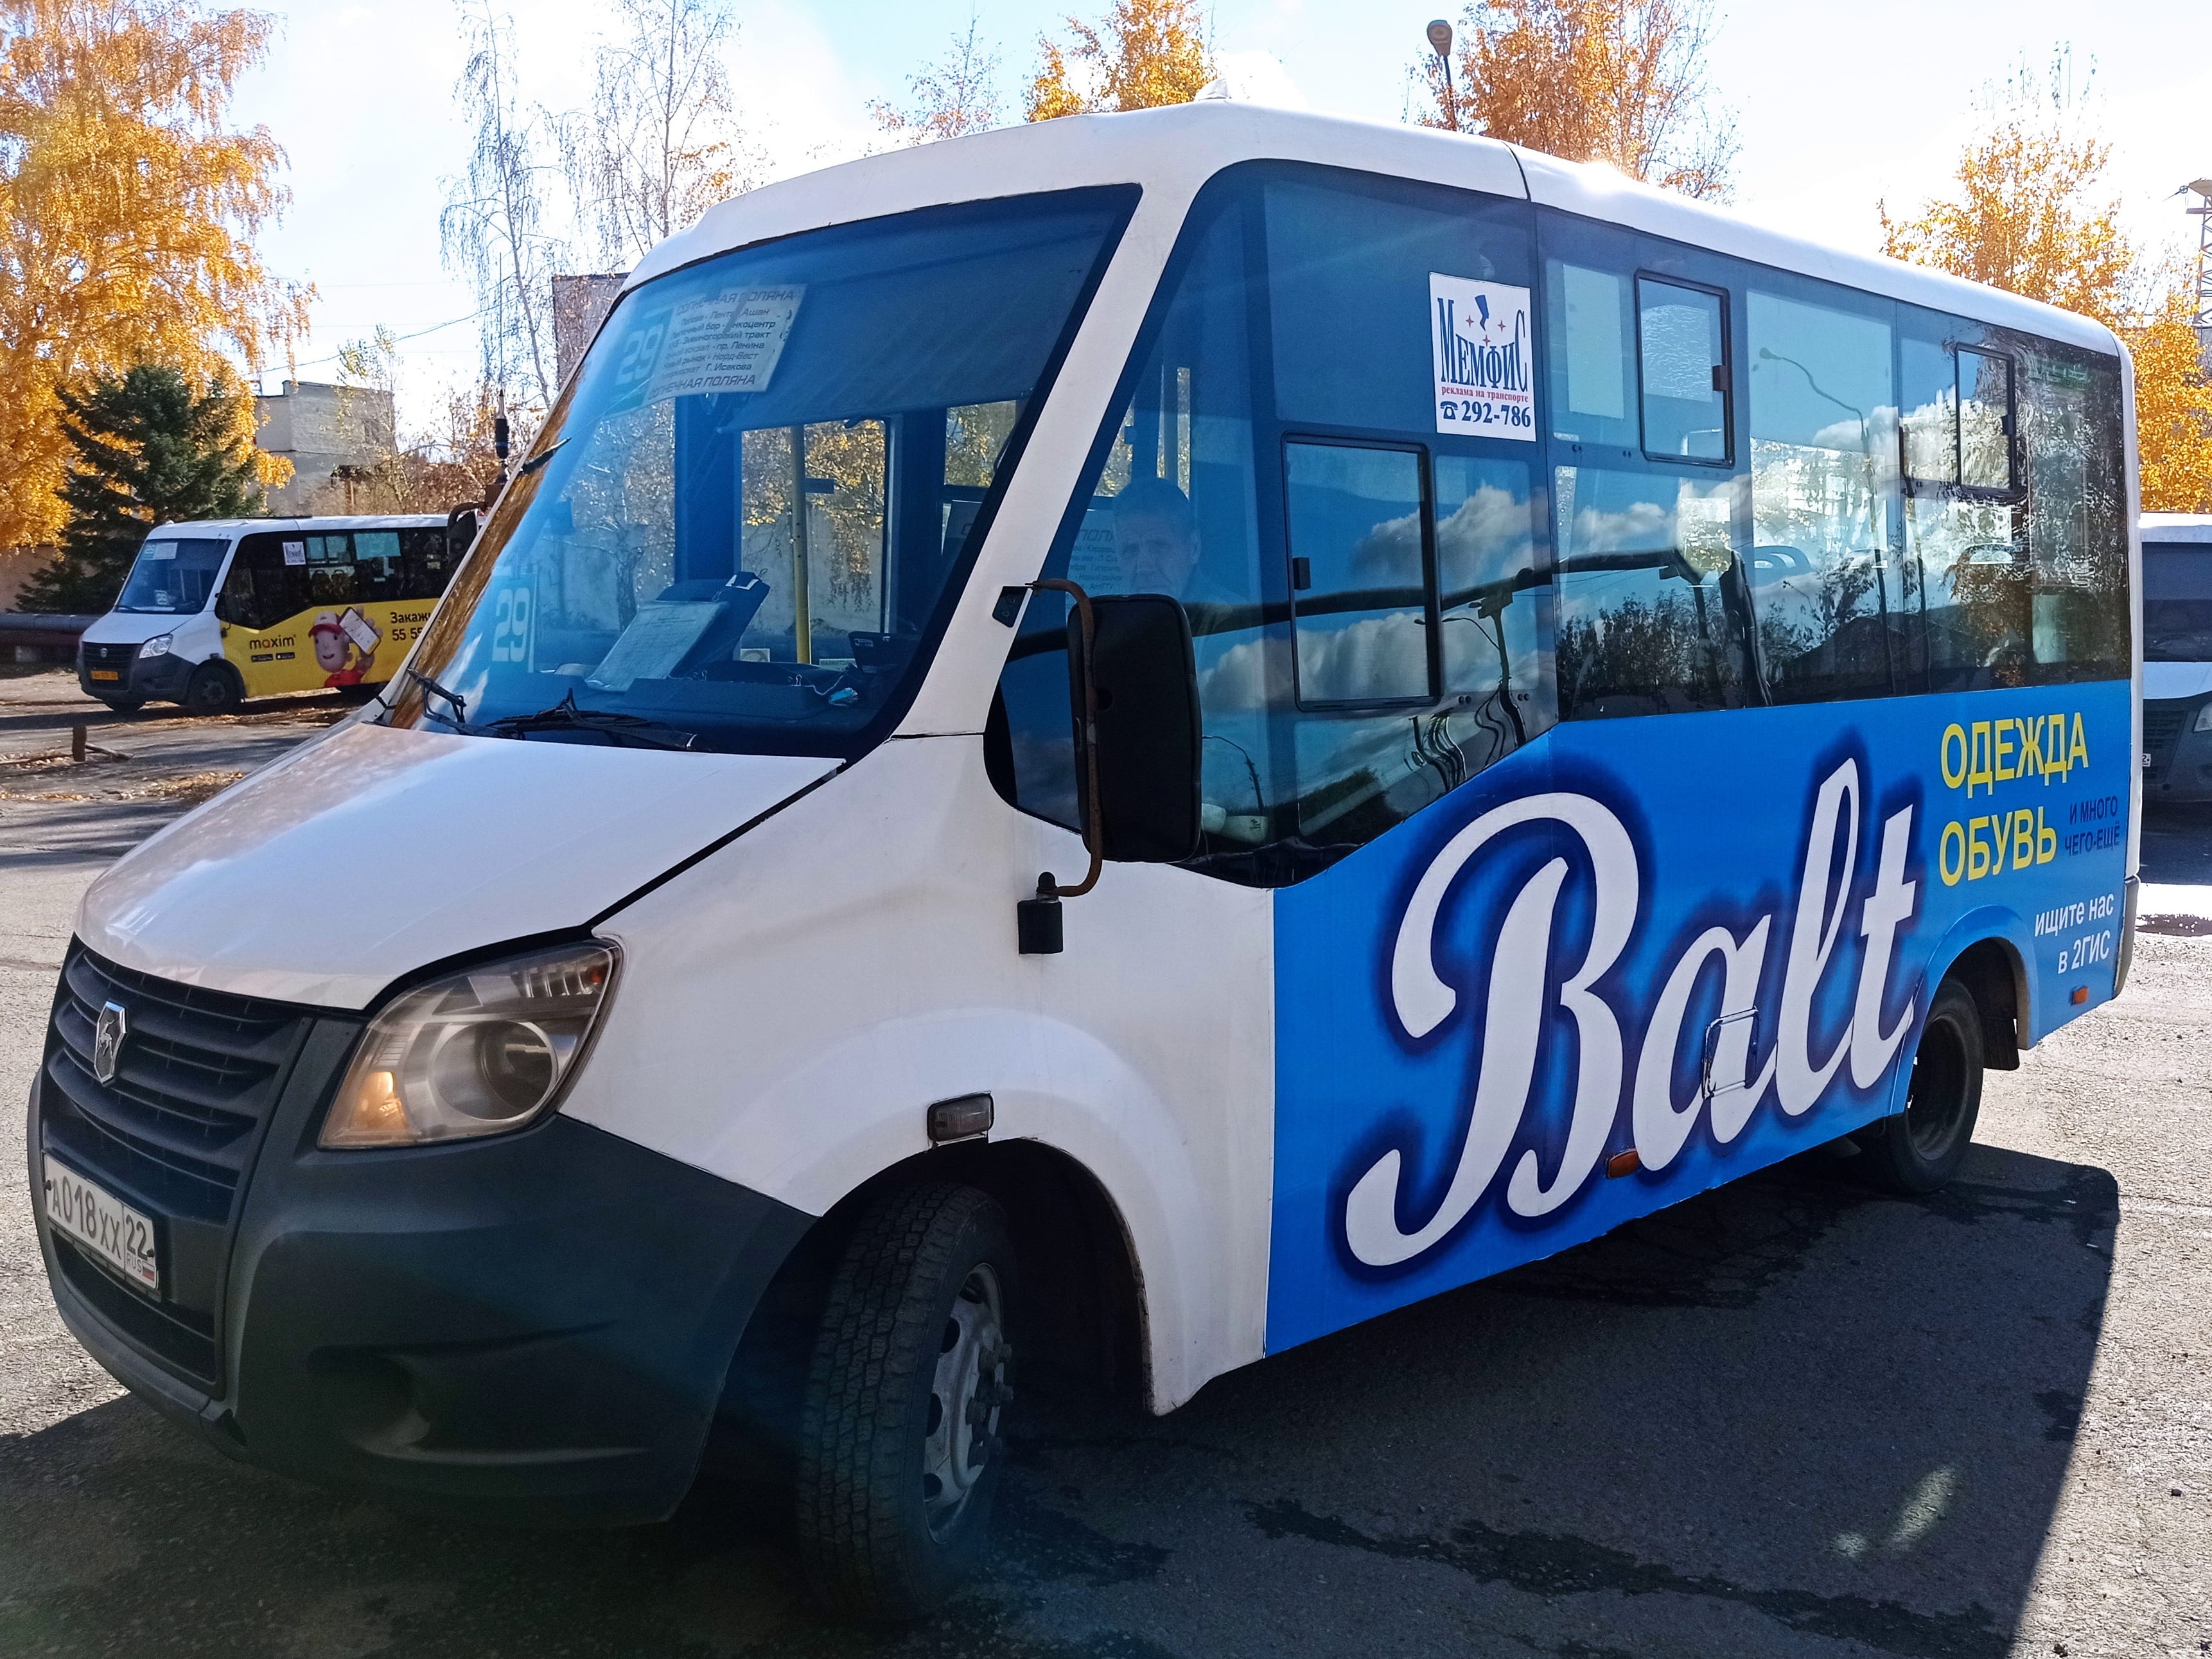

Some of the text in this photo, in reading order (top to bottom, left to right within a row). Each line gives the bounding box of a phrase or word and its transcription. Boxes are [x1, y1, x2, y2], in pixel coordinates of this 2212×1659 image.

[741, 308, 769, 316] Ашан
[706, 322, 721, 331] бор
[745, 332, 771, 340] тракт
[616, 323, 664, 385] 29
[712, 351, 759, 362] Норд-Вест
[714, 362, 752, 371] Исакова
[703, 375, 755, 387] ПОЛЯНА
[1441, 386, 1473, 396] реклама
[1487, 391, 1528, 403] транспорте
[1461, 399, 1531, 427] 292-786
[491, 586, 531, 662] 29
[250, 634, 295, 650] maxim
[1940, 712, 2089, 798] ОДЕЖДА
[2069, 796, 2118, 825] И МНОГО
[1939, 806, 2057, 887] ОБУВЬ
[2034, 893, 2115, 937] ищите нас
[2057, 929, 2111, 974] в 2ГИС
[1346, 757, 1917, 1266] Balt
